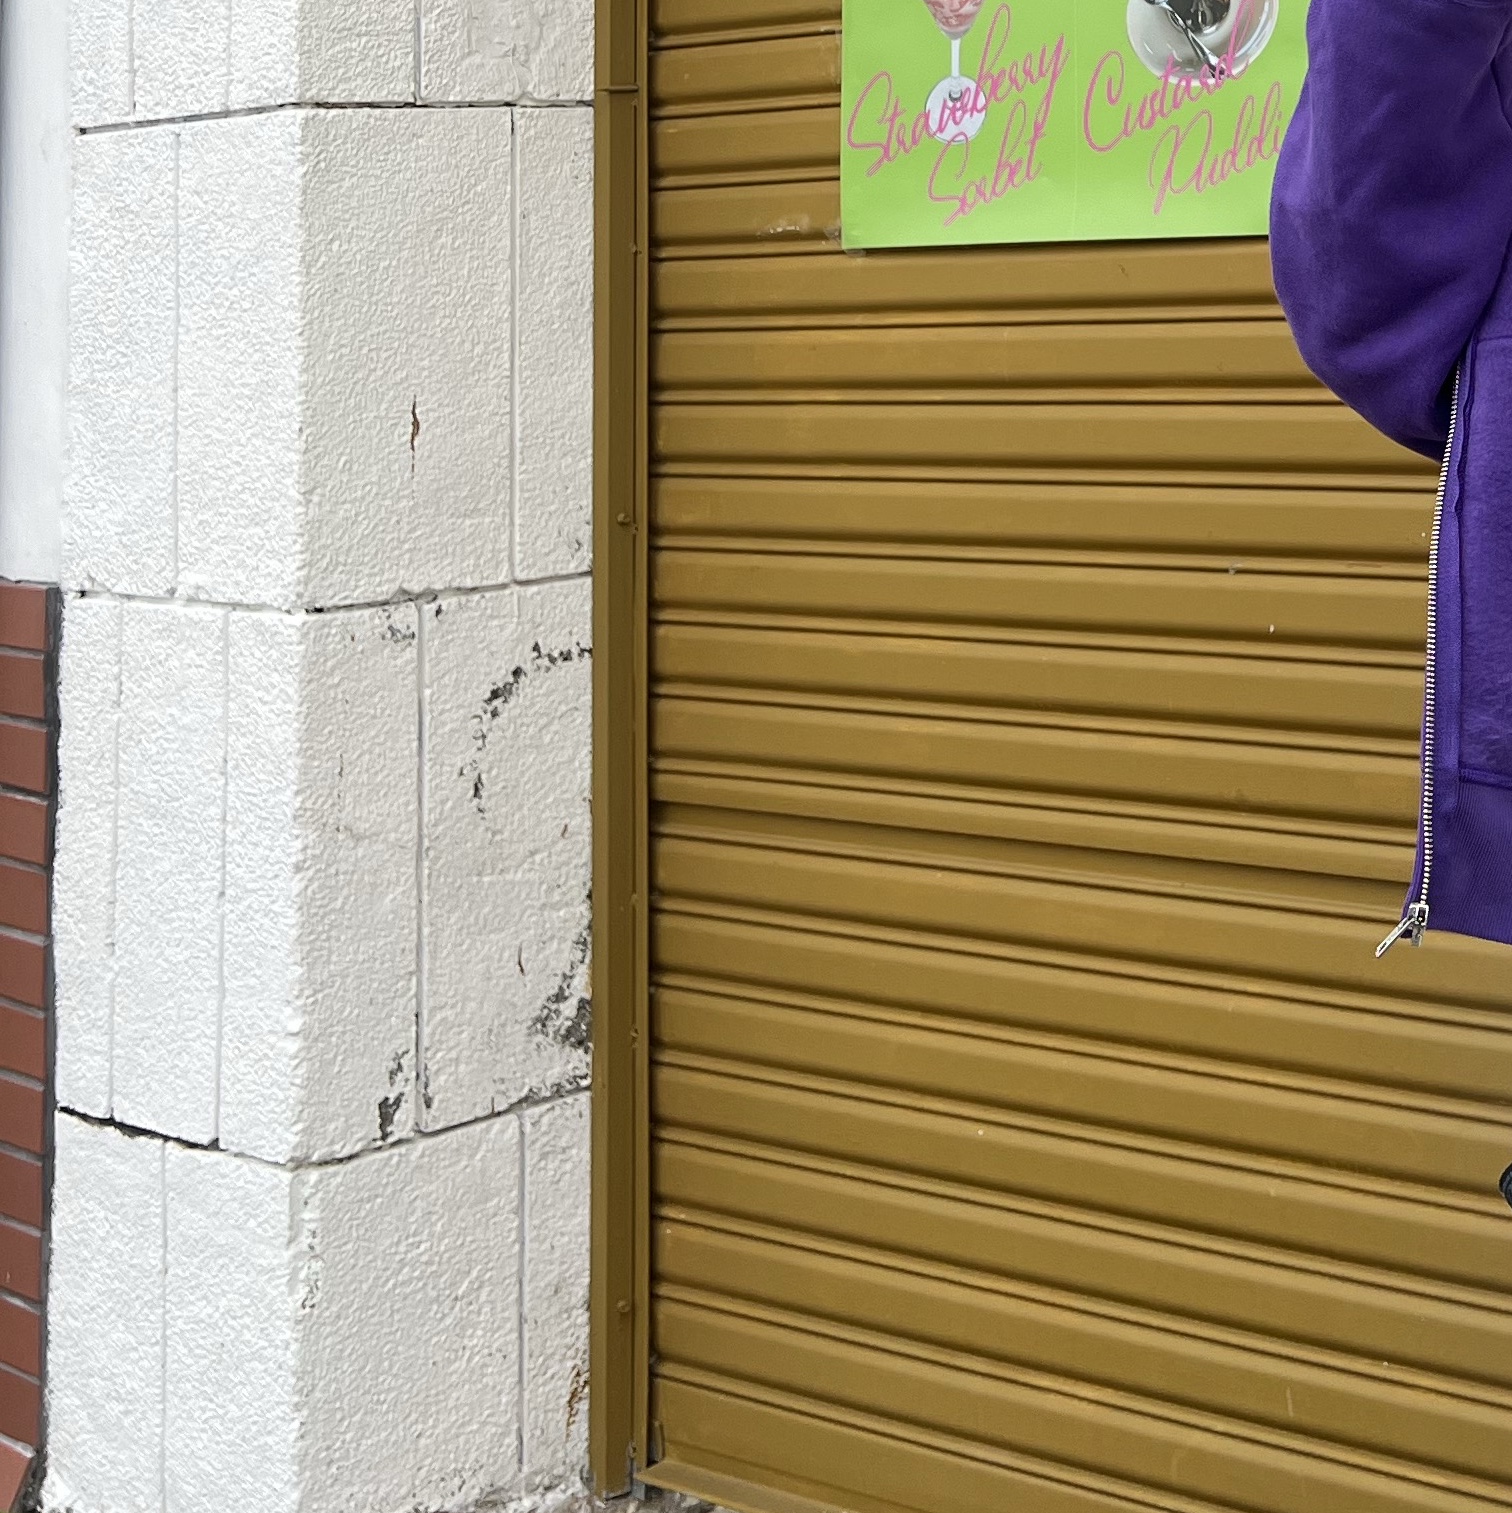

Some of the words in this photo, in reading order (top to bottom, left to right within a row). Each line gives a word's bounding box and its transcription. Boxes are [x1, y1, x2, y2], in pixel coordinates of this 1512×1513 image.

[847, 2, 1071, 176] Strawberry
[1149, 82, 1285, 216] Puddi
[927, 99, 1044, 228] Sorbet
